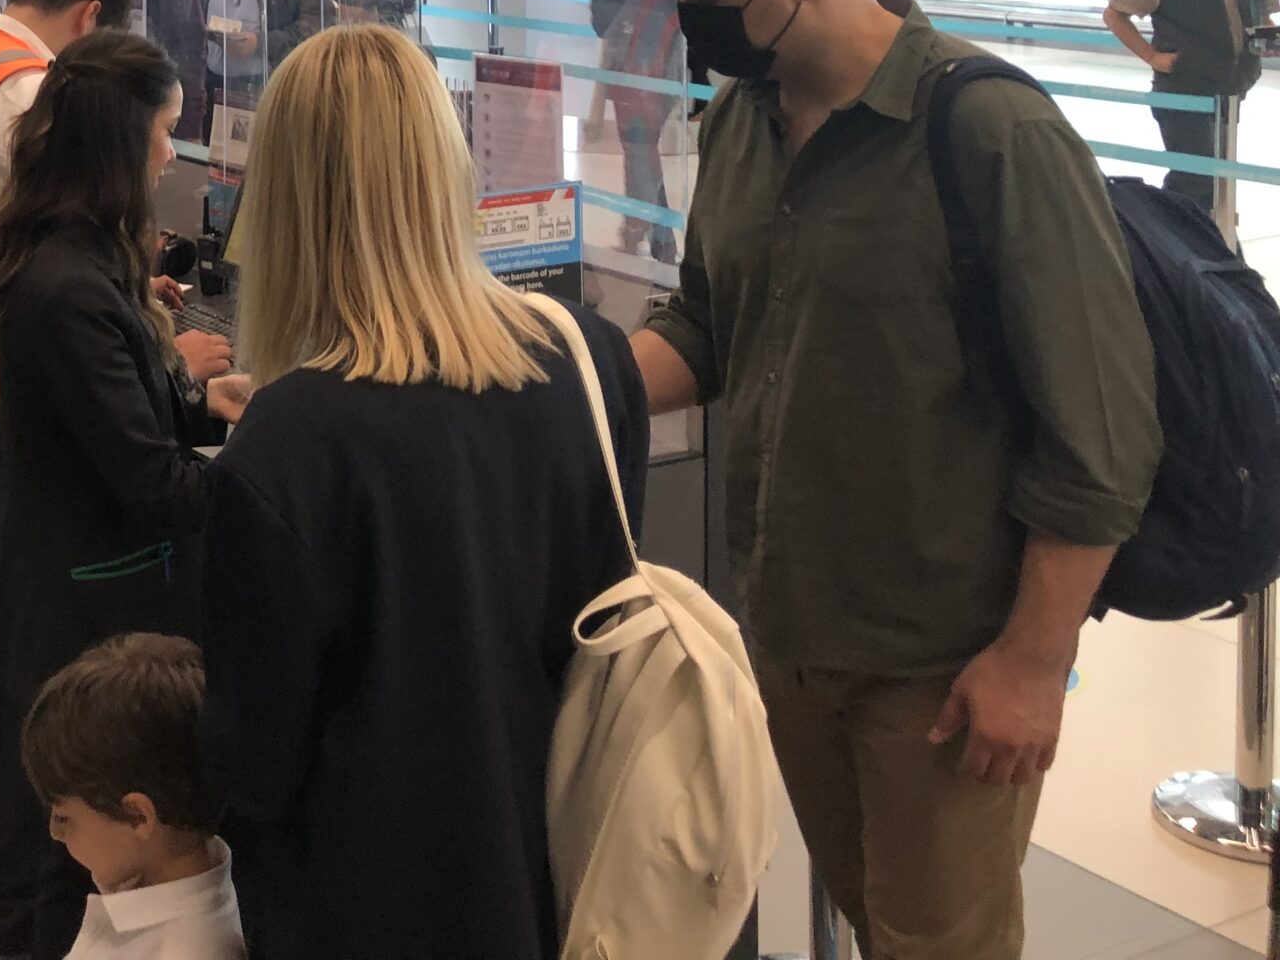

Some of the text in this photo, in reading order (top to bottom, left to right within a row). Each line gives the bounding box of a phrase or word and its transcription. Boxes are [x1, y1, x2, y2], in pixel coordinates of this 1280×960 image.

[511, 270, 539, 281] barcode
[539, 268, 548, 277] of
[549, 268, 564, 278] your
